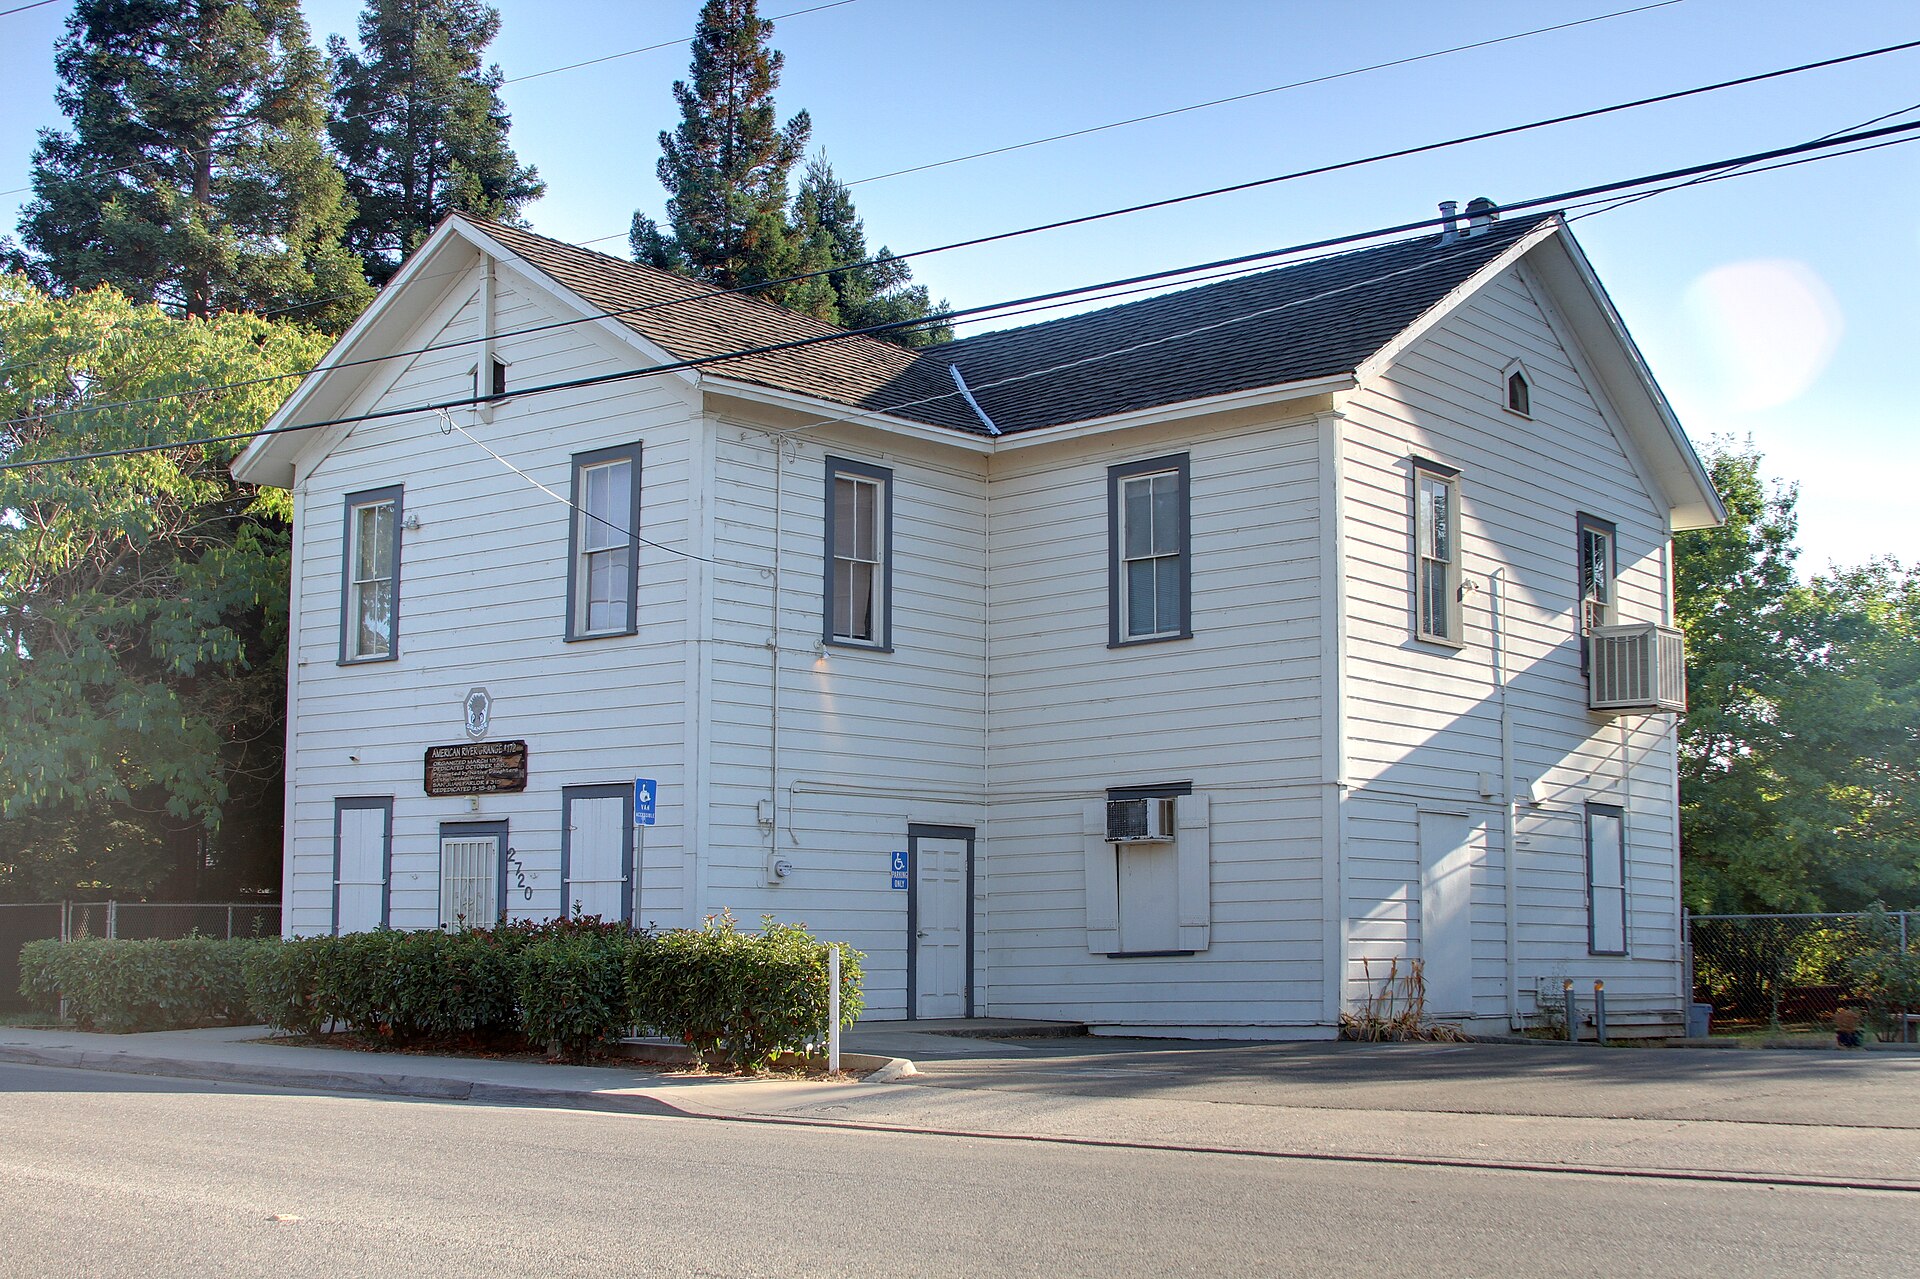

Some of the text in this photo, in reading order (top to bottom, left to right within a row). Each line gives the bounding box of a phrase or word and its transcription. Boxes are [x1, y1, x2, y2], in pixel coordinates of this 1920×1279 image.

[466, 722, 488, 730] GRANGE
[432, 748, 461, 758] AMERICAN
[462, 747, 478, 756] RIVER
[479, 744, 502, 754] GRANGE
[508, 847, 533, 901] 2720
